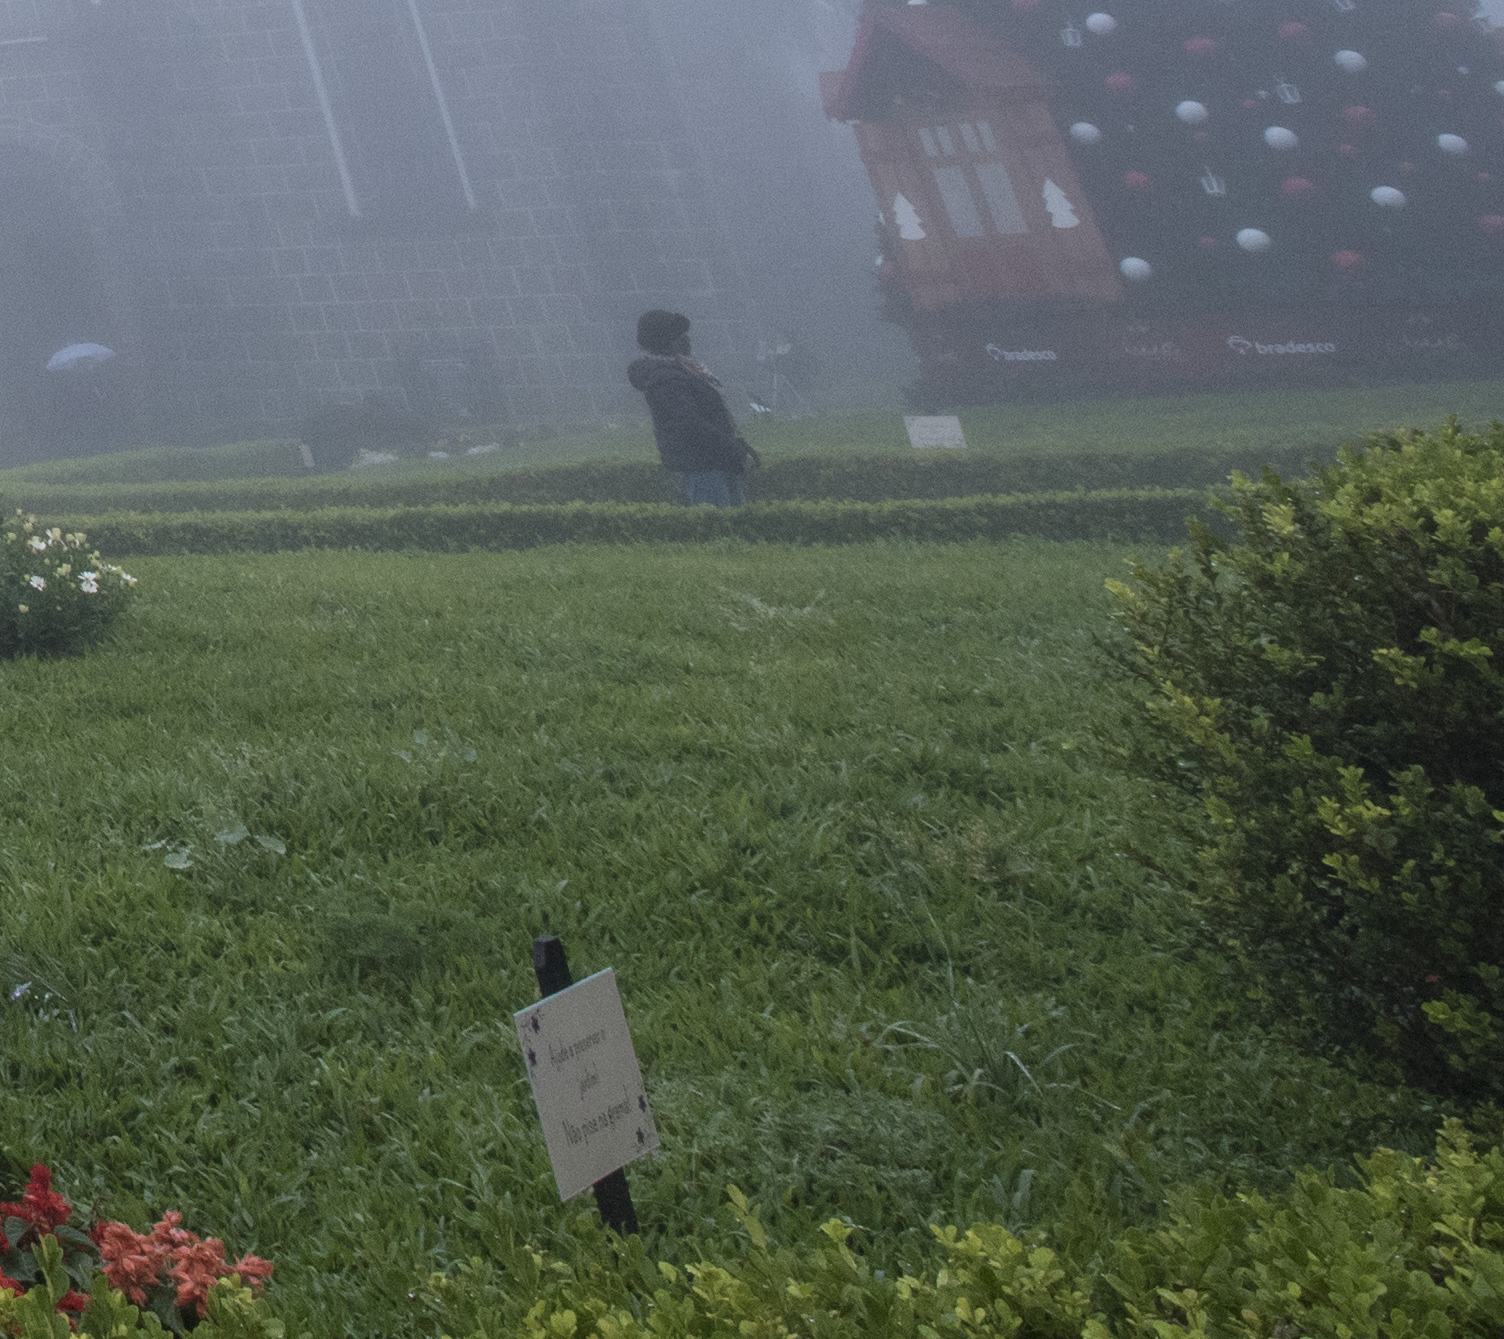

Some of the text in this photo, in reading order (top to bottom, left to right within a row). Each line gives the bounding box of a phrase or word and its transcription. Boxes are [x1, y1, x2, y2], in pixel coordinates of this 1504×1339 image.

[1254, 341, 1336, 354] bradesco
[1000, 348, 1057, 361] bradesco
[562, 1119, 582, 1147] Não
